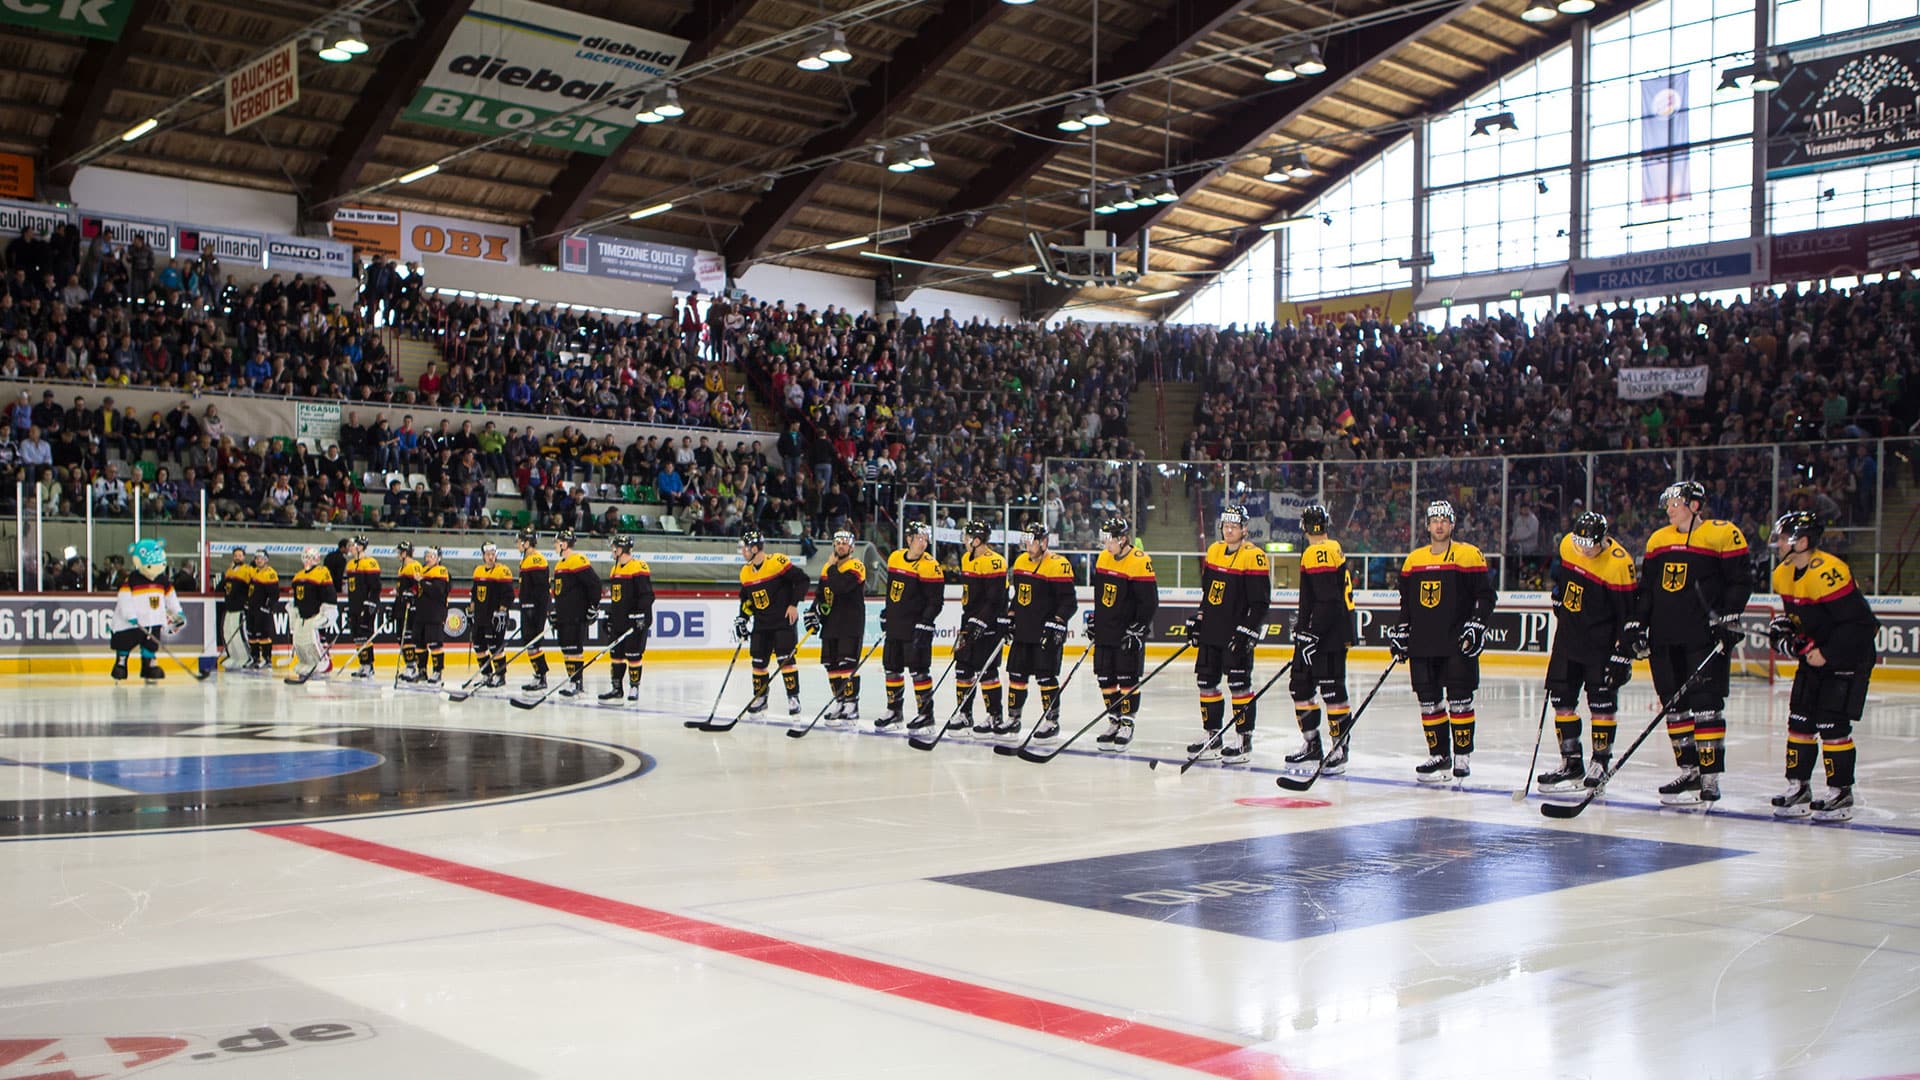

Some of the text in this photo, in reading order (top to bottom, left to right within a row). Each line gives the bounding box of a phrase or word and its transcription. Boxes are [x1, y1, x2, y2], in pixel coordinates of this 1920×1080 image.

[582, 36, 677, 66] diebald
[231, 47, 291, 101] RAUCHEN
[230, 74, 294, 128] VERBOTEN
[421, 92, 619, 146] BLOCK
[201, 237, 258, 258] culinario
[411, 224, 509, 262] OBI
[597, 242, 688, 267] TIMEZONE OUTLET
[1609, 246, 1710, 267] RECHTSANWALT
[1599, 259, 1723, 290] FRANZ RÖCKL
[301, 405, 340, 414] PEGASUS
[1733, 530, 1741, 545] 2
[1316, 550, 1329, 563] 21
[1820, 567, 1845, 587] 34
